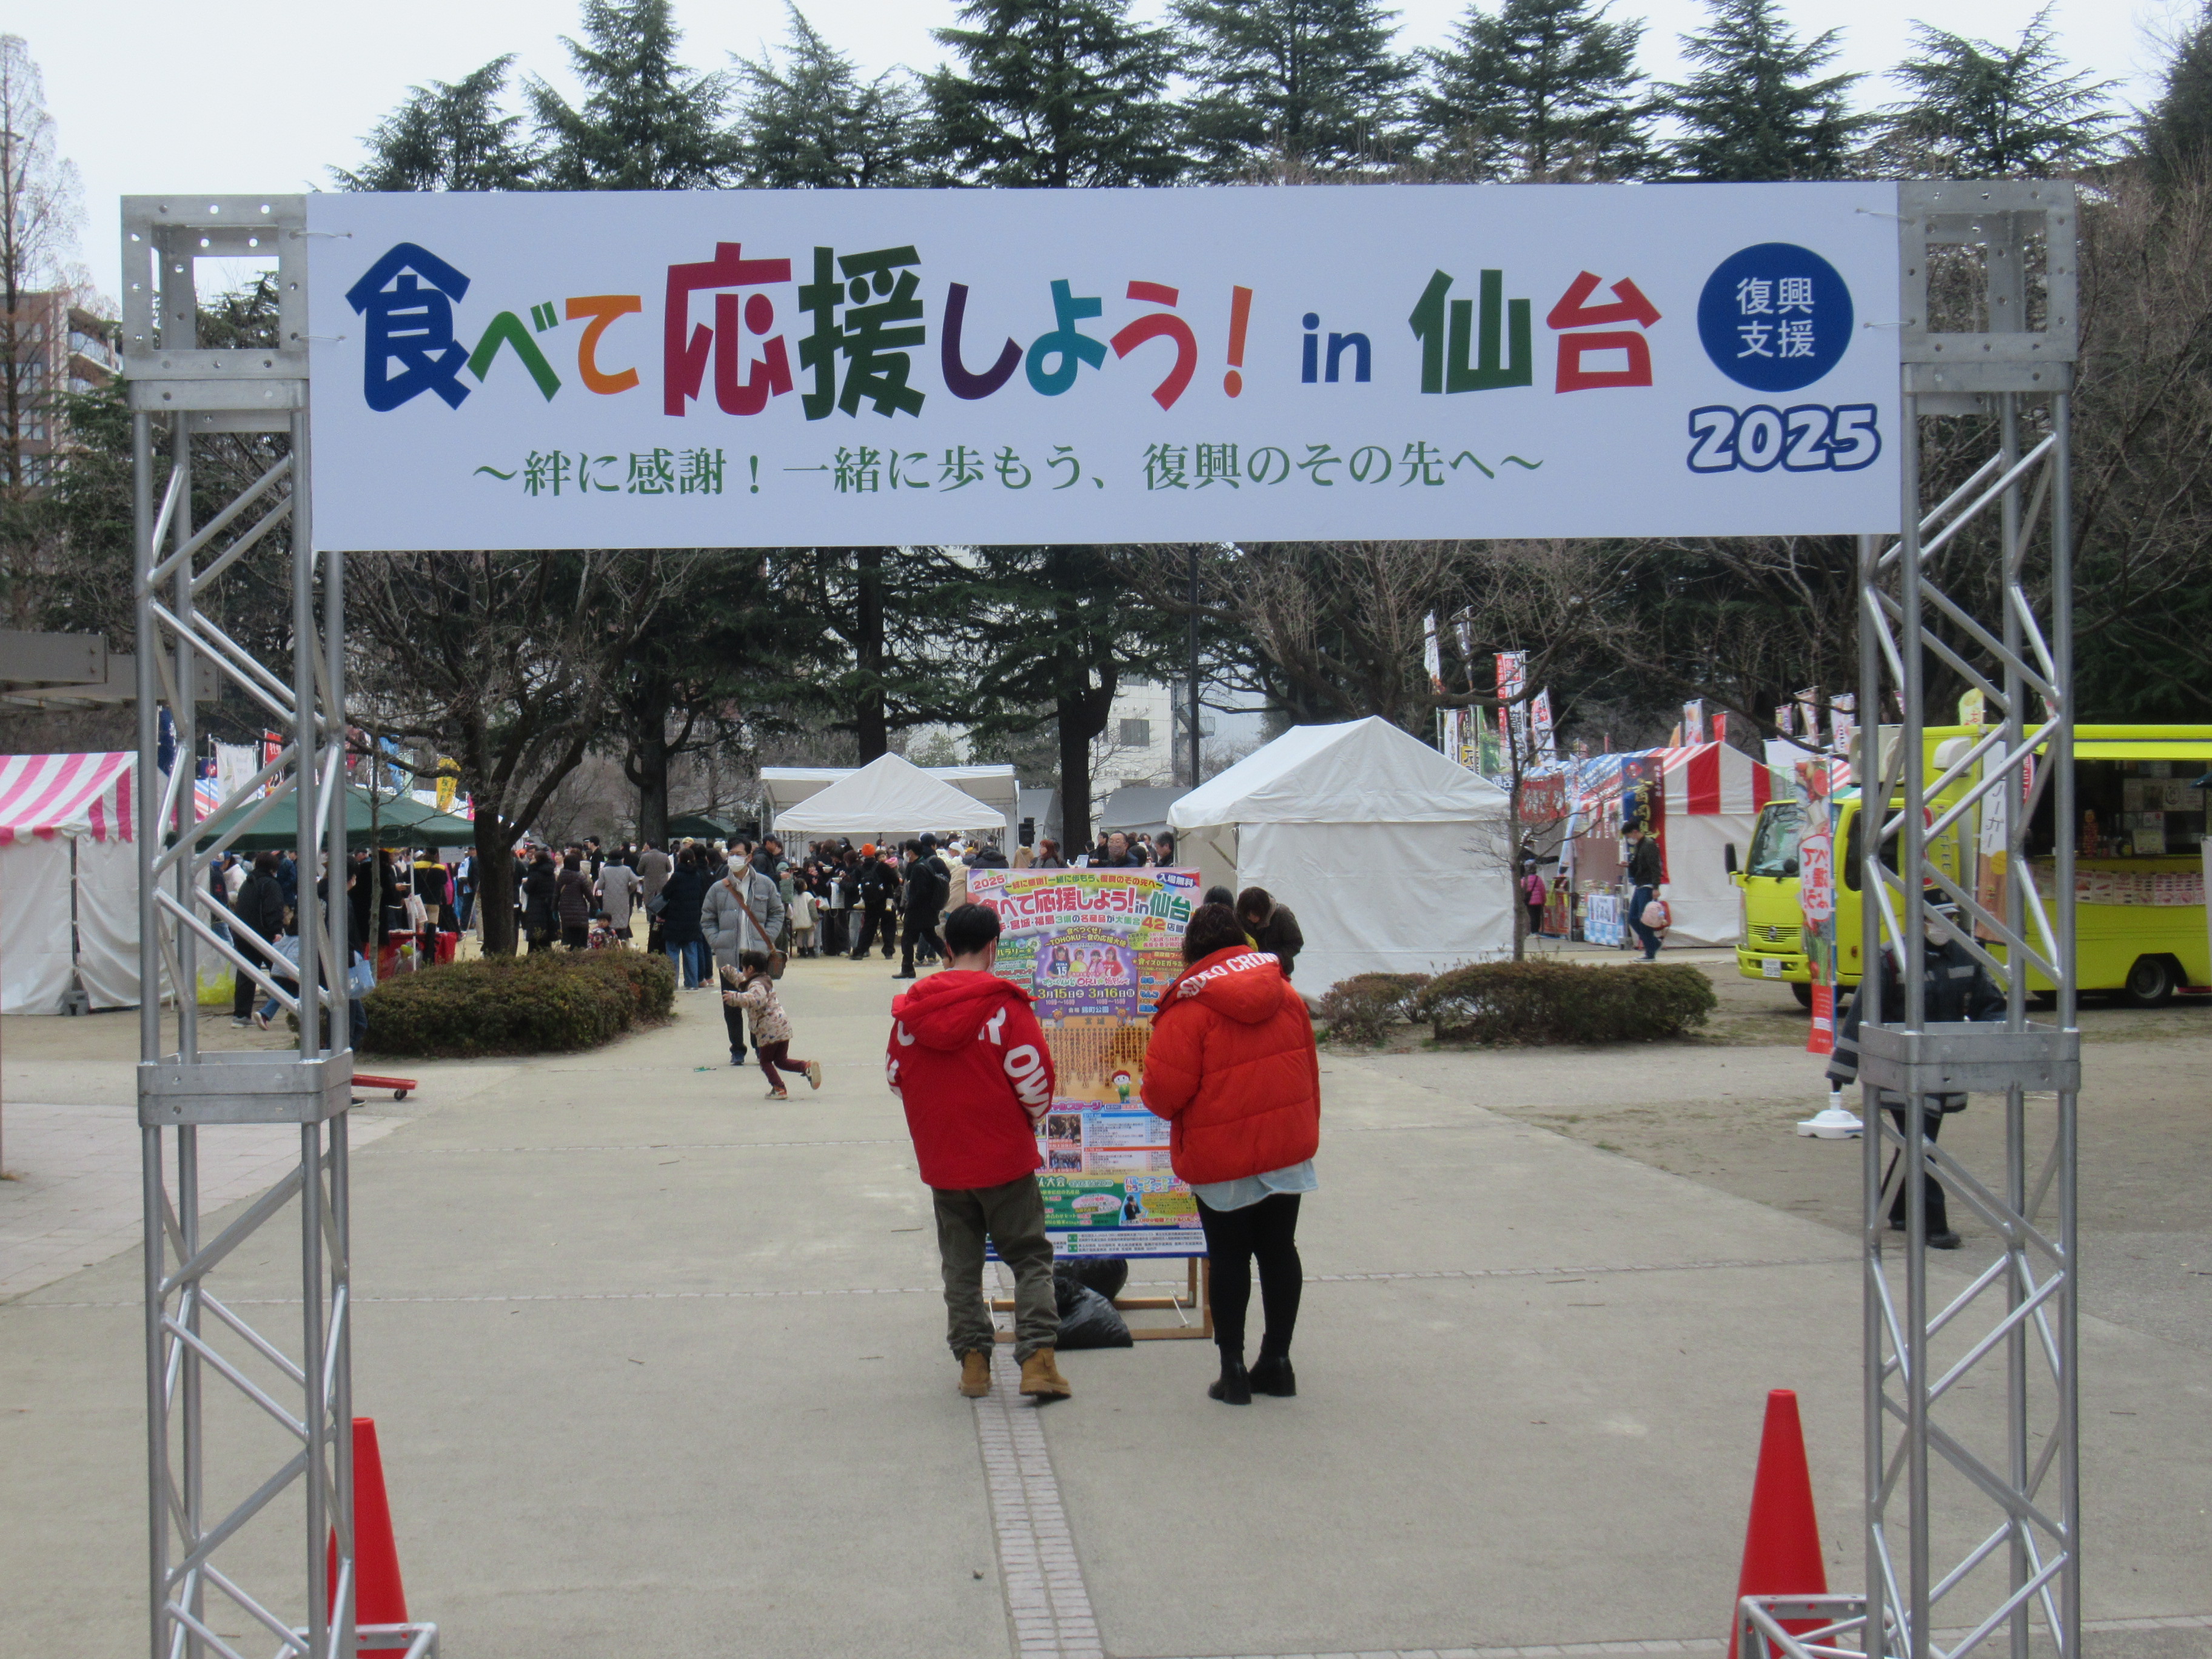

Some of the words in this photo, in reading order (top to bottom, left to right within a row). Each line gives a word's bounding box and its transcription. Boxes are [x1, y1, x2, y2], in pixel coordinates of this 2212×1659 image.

[1736, 276, 1815, 317] 復興
[345, 242, 1253, 421] 食べて応援しよう!
[1302, 312, 1370, 383] in
[1409, 269, 1662, 395] 仙台
[1736, 320, 1815, 359] 支援
[1688, 404, 1882, 474] 2025
[973, 875, 1005, 890] 2025
[1159, 873, 1193, 886] 入場無料
